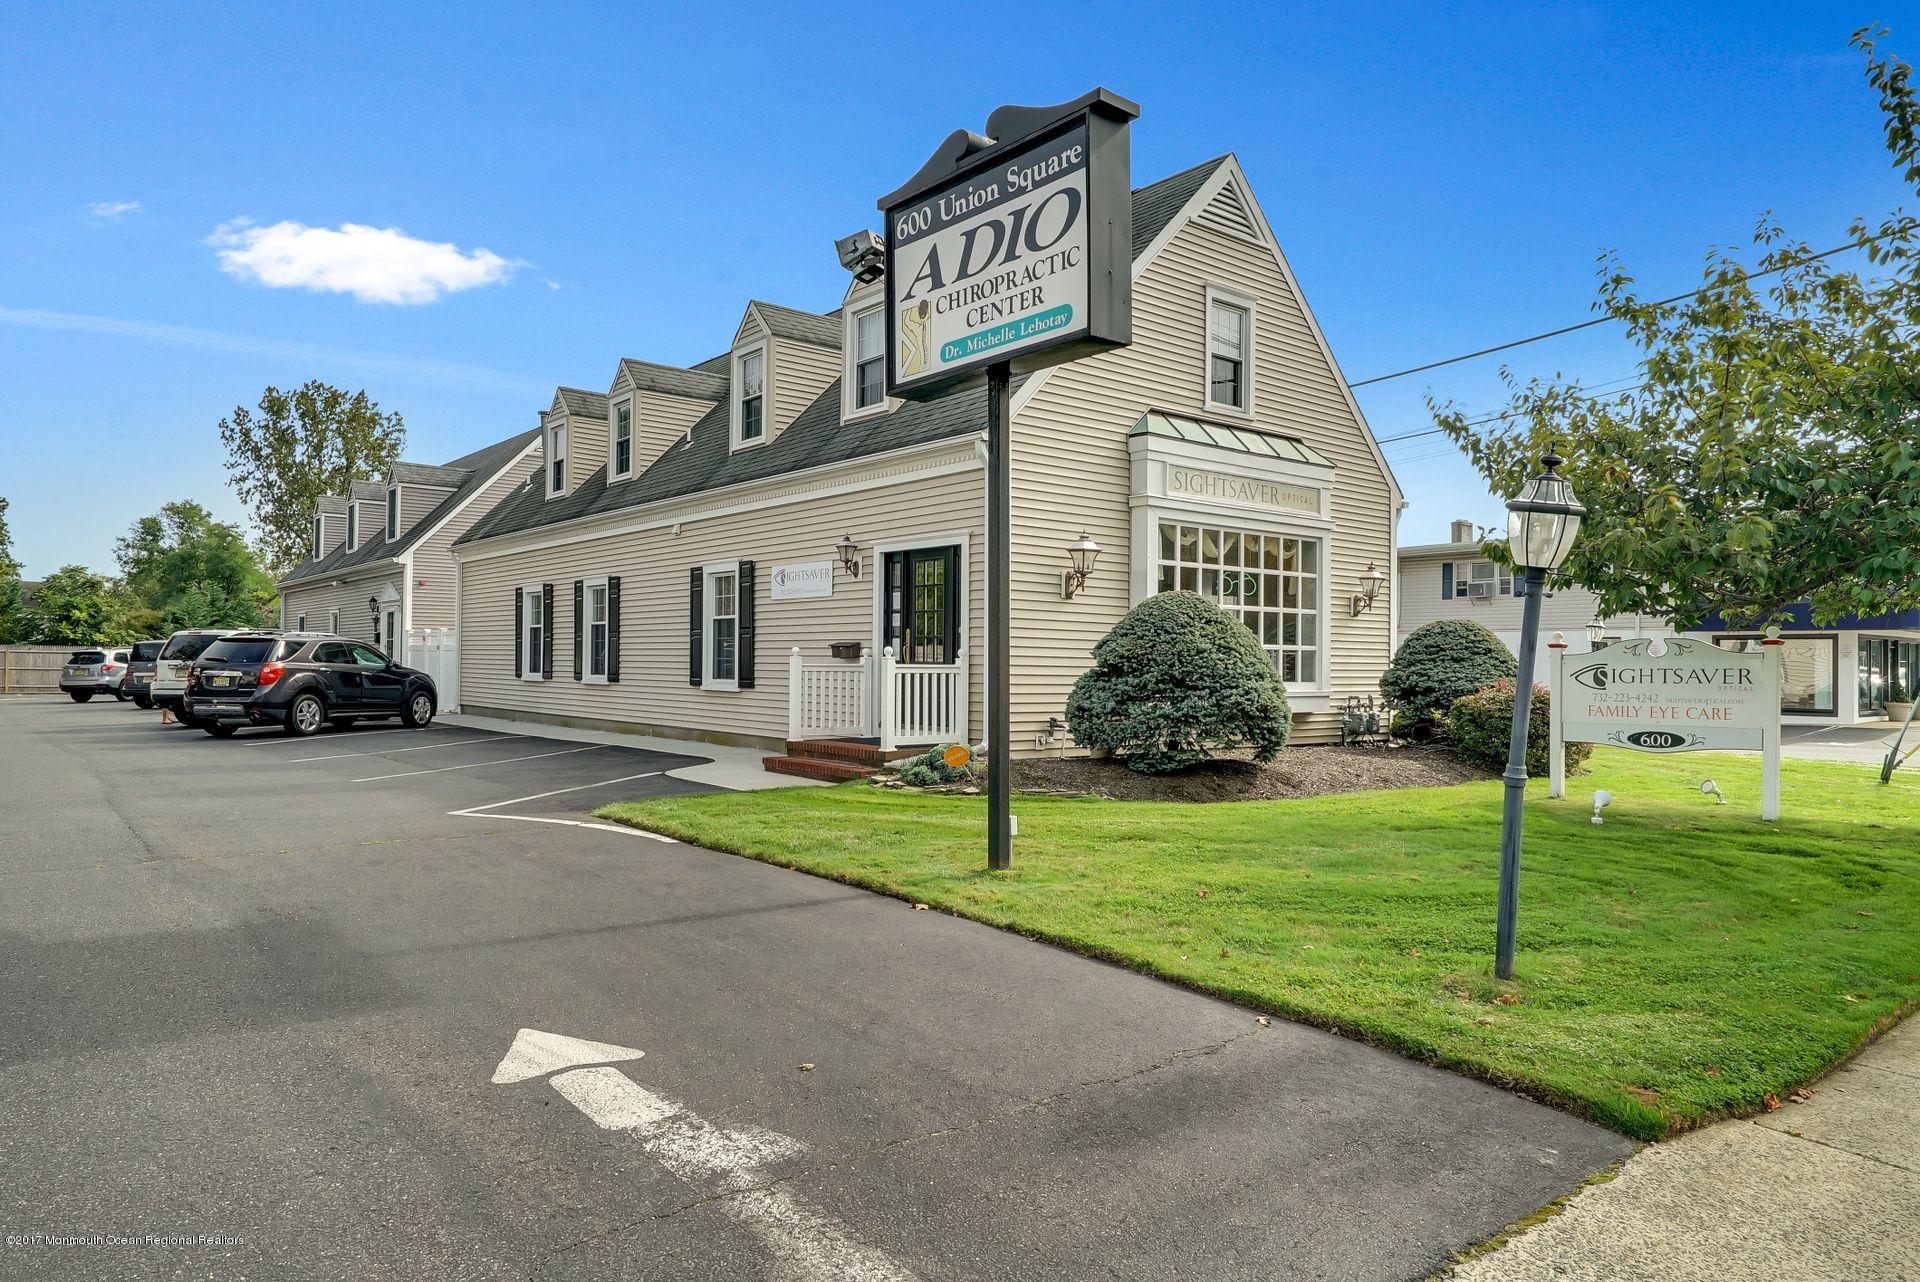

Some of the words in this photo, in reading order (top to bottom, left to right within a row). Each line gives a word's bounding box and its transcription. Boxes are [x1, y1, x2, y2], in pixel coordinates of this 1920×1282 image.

[896, 207, 931, 240] 600
[938, 183, 1000, 221] Union
[1006, 144, 1083, 193] Square
[900, 187, 1082, 302] ADIO
[936, 245, 1080, 315] CHIROPRACTIC
[966, 286, 1045, 328] CENTER
[945, 344, 962, 359] Dr.
[966, 329, 1015, 350] Michelle
[1020, 311, 1067, 336] Lehotay
[1174, 471, 1280, 505] SIGHTSAVER
[1592, 667, 1753, 687] SIGHTSAVER
[1588, 705, 1642, 717] FAMILY
[1650, 706, 1679, 719] EYE
[1686, 707, 1732, 720] CARE
[1592, 693, 1659, 703] 732-223-4242
[1640, 734, 1672, 747] 600
